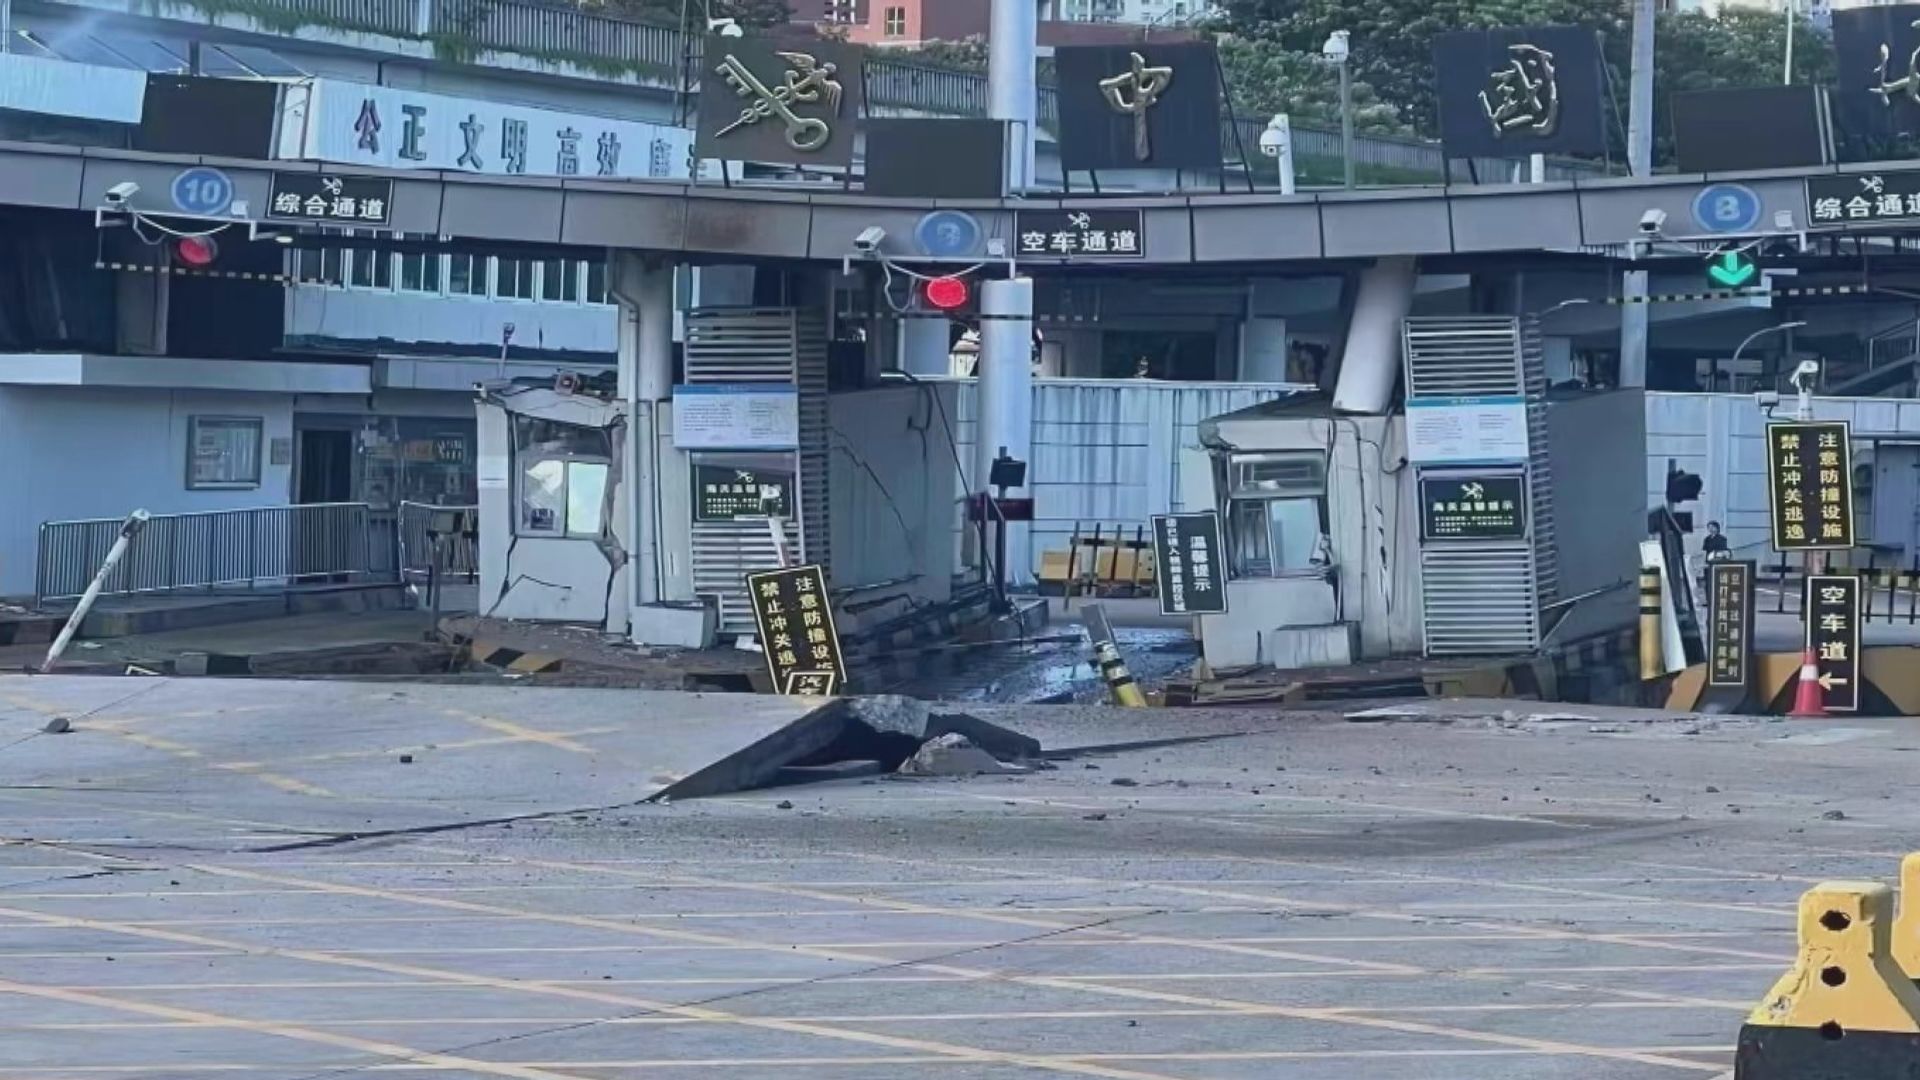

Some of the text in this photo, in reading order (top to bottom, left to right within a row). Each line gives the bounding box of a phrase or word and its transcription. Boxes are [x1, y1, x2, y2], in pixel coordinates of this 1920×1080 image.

[354, 98, 427, 162] 公正
[457, 113, 528, 174] 文明
[557, 126, 622, 176] 高效
[1099, 52, 1173, 161] 中
[184, 178, 221, 204] 10
[1714, 195, 1741, 221] 8
[1021, 230, 1137, 253] 空车通道
[1779, 433, 1806, 540] 禁止冲关逃逸
[1817, 431, 1843, 538] 注意防撞设施
[760, 581, 798, 678] 禁止冲关逃
[1819, 585, 1848, 661] 空车道
